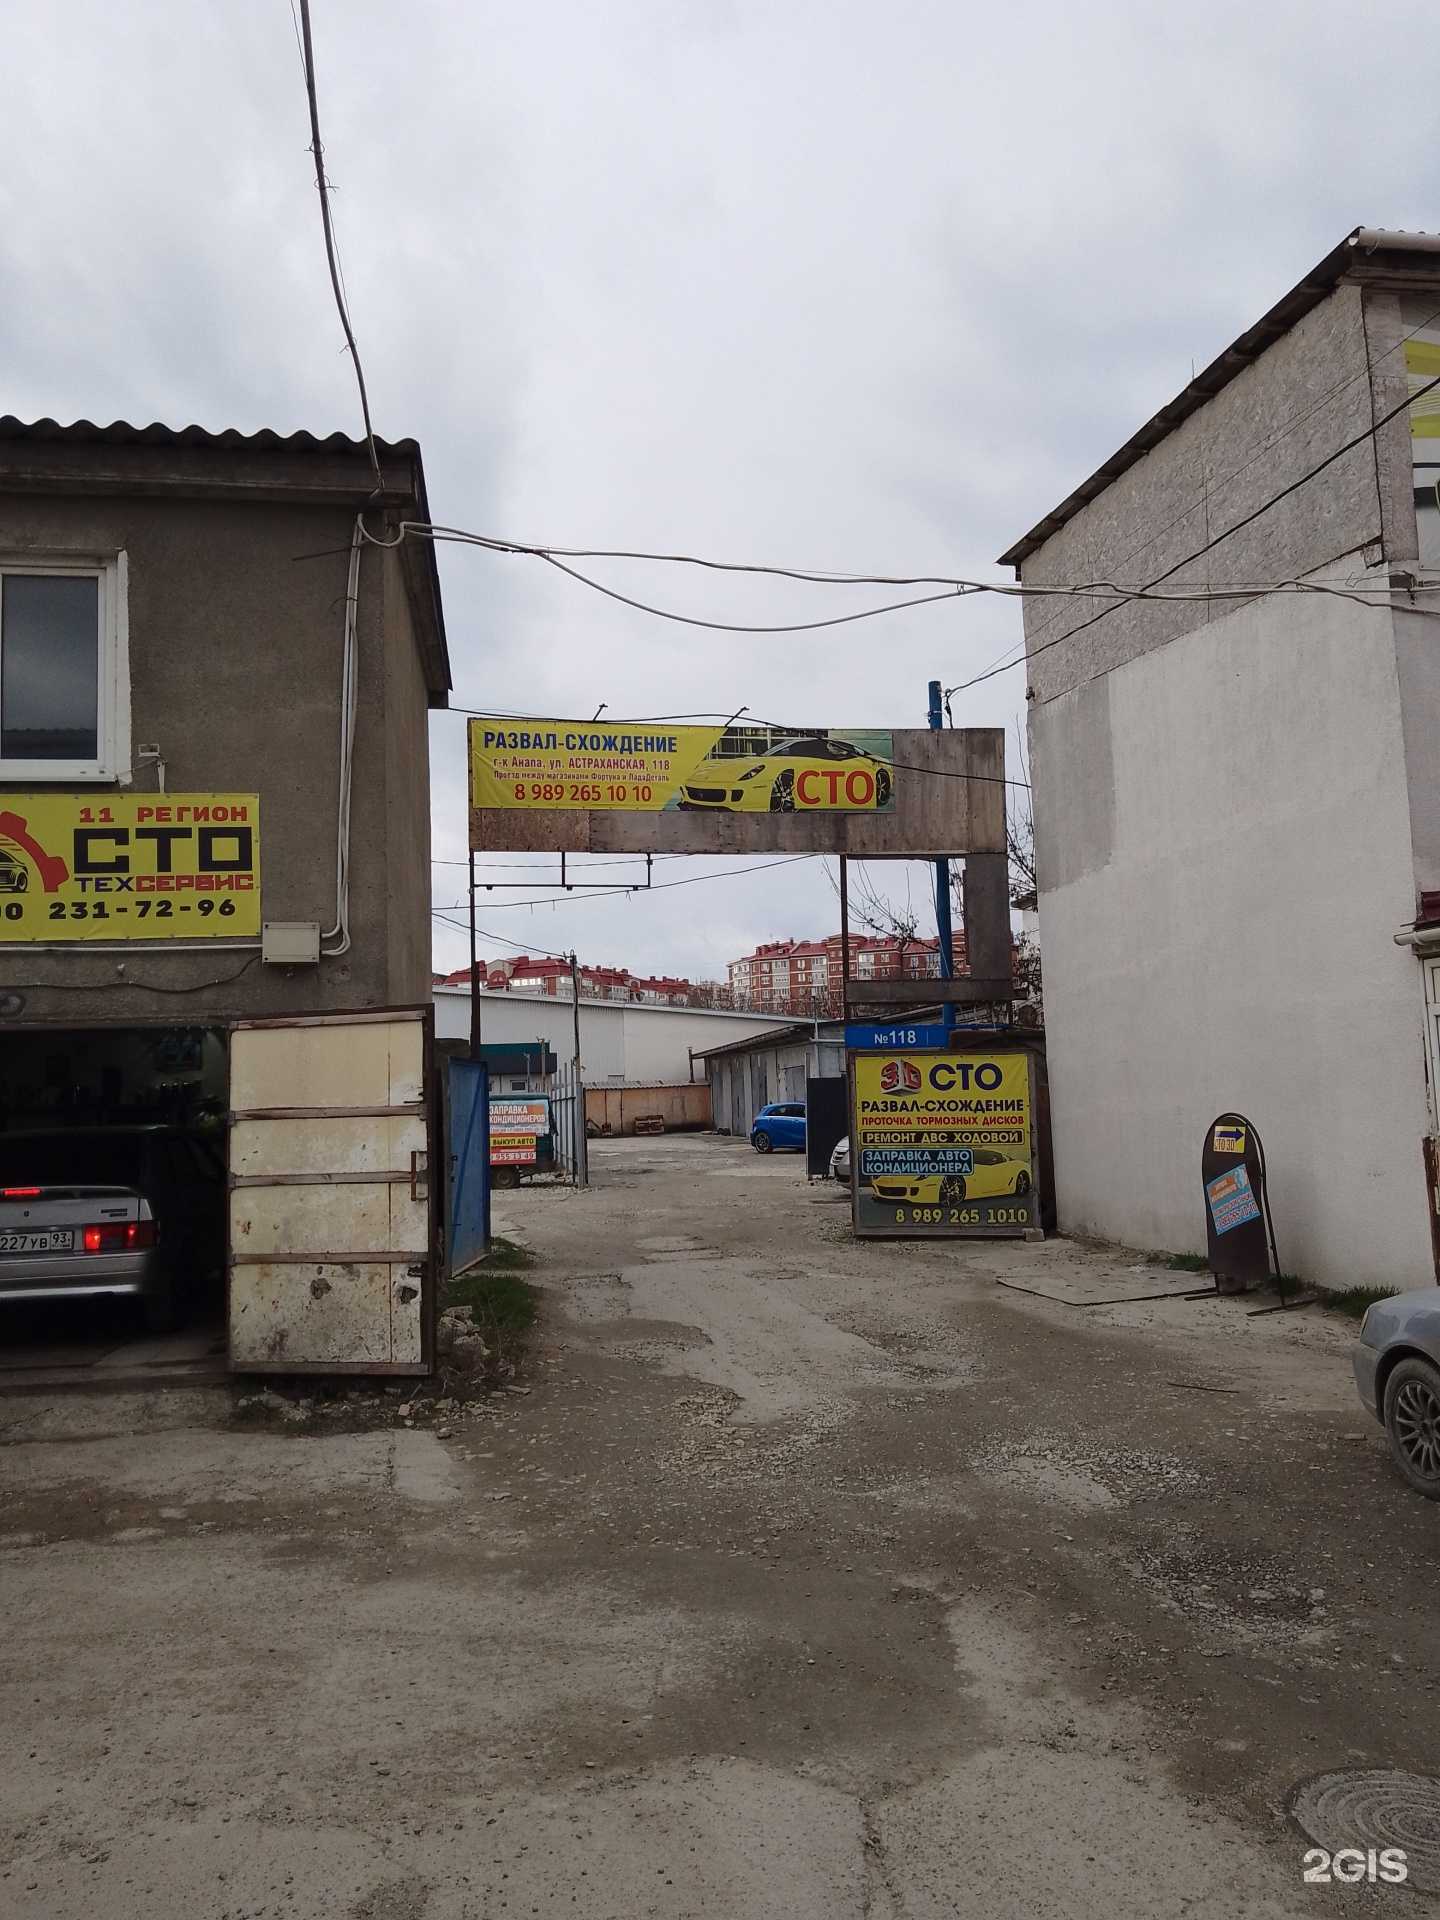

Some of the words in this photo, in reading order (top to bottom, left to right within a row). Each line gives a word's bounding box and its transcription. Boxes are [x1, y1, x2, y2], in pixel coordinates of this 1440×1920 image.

[484, 732, 677, 754] РАЗВАЛ-СХОЖДЕНИЕ
[512, 756, 546, 769] Анапа,
[550, 759, 564, 770] ул.
[569, 757, 648, 771] АСТРАХАНСКАЯ,
[653, 760, 670, 770] 118
[515, 784, 526, 800] 8
[532, 784, 564, 801] 989
[570, 784, 601, 801] 265
[608, 785, 626, 802] 10
[633, 785, 651, 802] 10
[796, 770, 874, 805] СТО
[79, 807, 115, 823] 11
[137, 806, 248, 823] РЕГИОН
[74, 827, 253, 873] СТО
[74, 875, 254, 893] ТЕХСЕРВИС
[49, 899, 236, 920] 231-72-96
[874, 1030, 917, 1045] №118
[929, 1063, 1003, 1091] СТО
[489, 1104, 528, 1115] ЗАПРАВКА
[861, 1099, 1024, 1114] РАЗВАЛ-СХОЖДЕНИЕ
[862, 1116, 912, 1126] ПРОТОЧКА
[917, 1116, 978, 1126] ТОРМОЗНЫХ
[982, 1115, 1024, 1126] ДИСКОВ
[866, 1132, 916, 1143] РЕМОНТ
[921, 1132, 948, 1144] ДВС
[954, 1130, 1019, 1144] ХОДОВОЙ
[866, 1151, 932, 1161] ЗАПРАВКА
[937, 1150, 970, 1161] АВТО
[866, 1161, 971, 1174] КОНДИЦИОНЕРА
[895, 1209, 905, 1222] 8
[912, 1209, 942, 1222] 989
[950, 1209, 980, 1223] 265
[987, 1208, 1028, 1223] 1010
